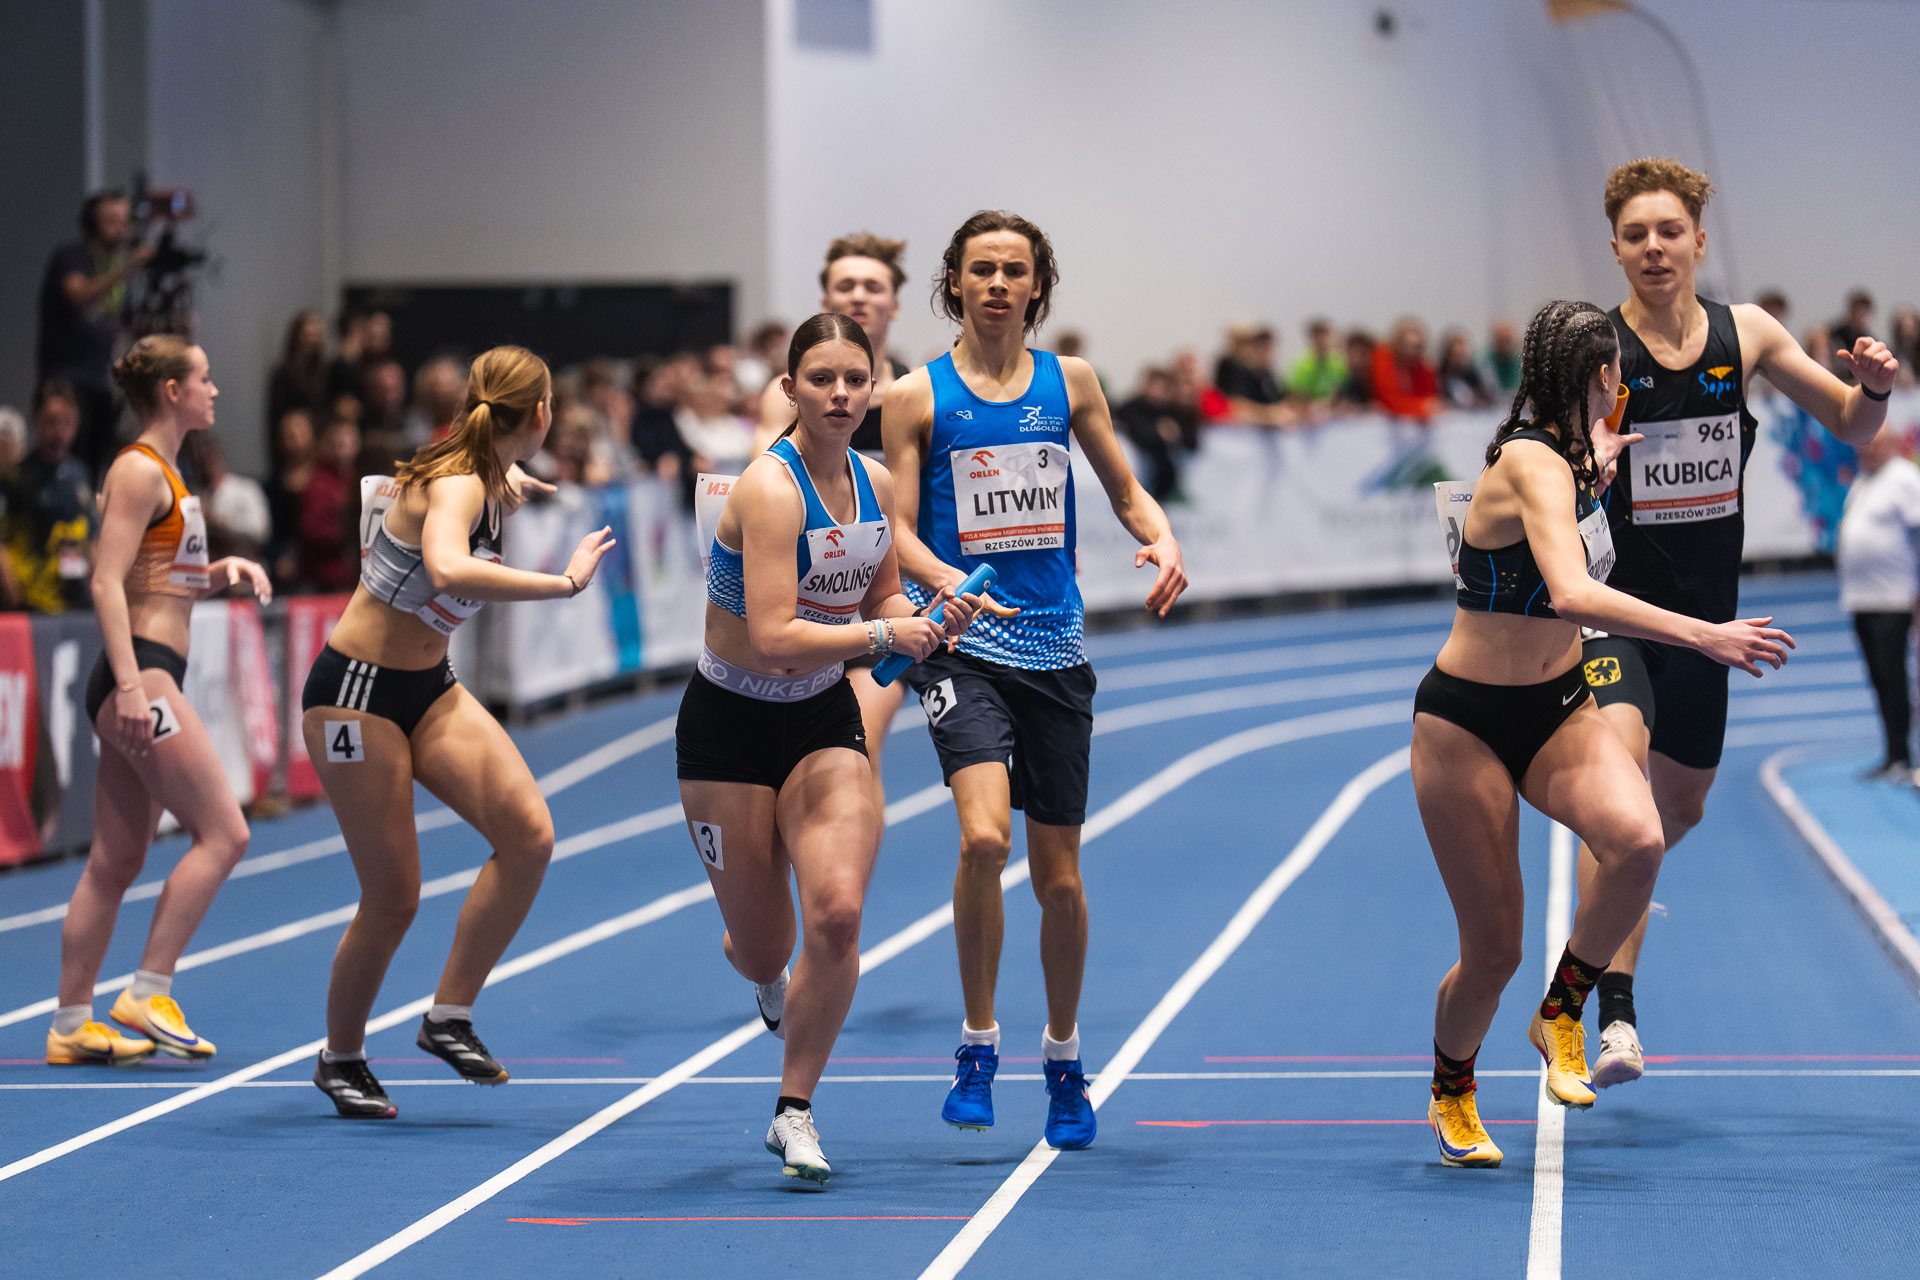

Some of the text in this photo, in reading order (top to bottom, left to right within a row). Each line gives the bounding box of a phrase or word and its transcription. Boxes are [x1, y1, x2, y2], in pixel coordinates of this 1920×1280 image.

[1697, 420, 1735, 443] 961
[1037, 449, 1048, 469] 3
[969, 469, 1000, 479] ORLEN
[1644, 457, 1733, 487] KUBICA
[973, 486, 1058, 516] LITWIN
[1655, 504, 1727, 521] RZESZÓW 2026
[874, 526, 886, 548] 7
[984, 536, 1058, 551] RZESZÓW 2026
[823, 549, 846, 559] ORLEN
[803, 609, 852, 624] RZESZÓW
[739, 675, 808, 697] NIKE
[927, 684, 947, 718] 3
[150, 706, 171, 738] 2
[332, 724, 355, 759] 4
[701, 825, 717, 863] 3
